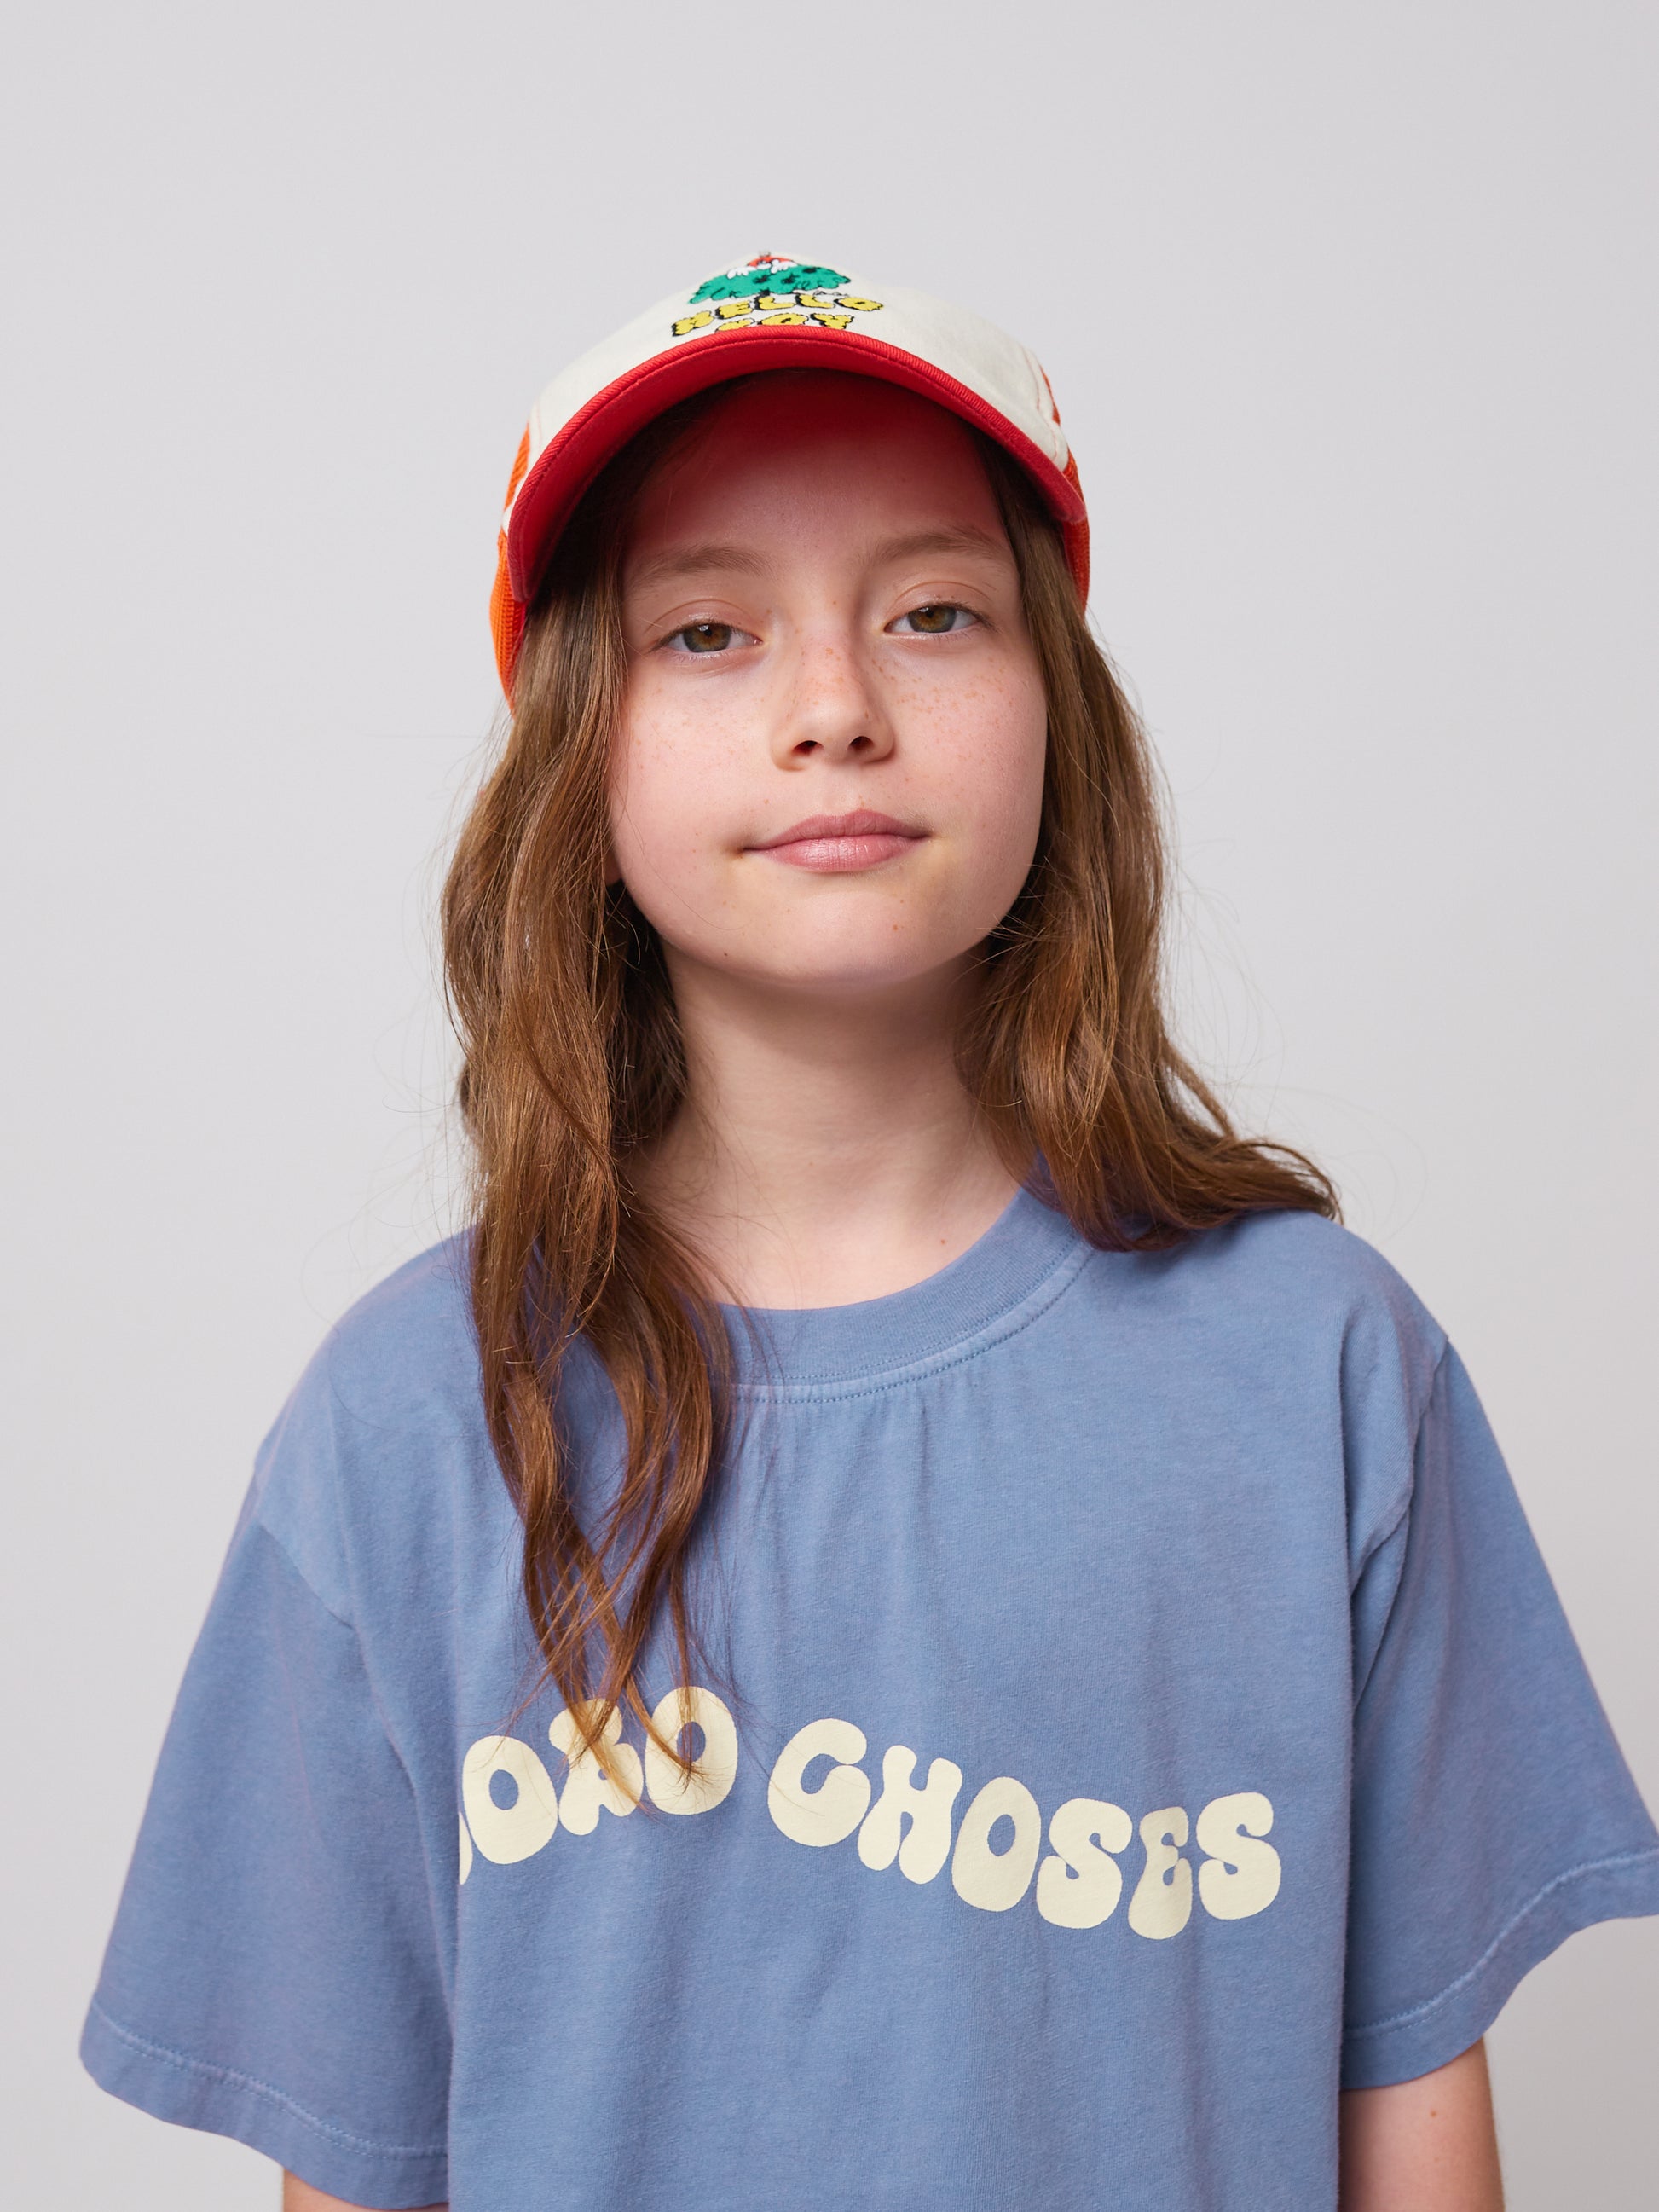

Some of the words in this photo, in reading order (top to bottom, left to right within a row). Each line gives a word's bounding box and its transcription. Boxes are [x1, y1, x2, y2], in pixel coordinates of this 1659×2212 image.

[672, 292, 884, 336] HELLO
[459, 1686, 738, 1885] OBO
[768, 1717, 1281, 1940] CHOSES
